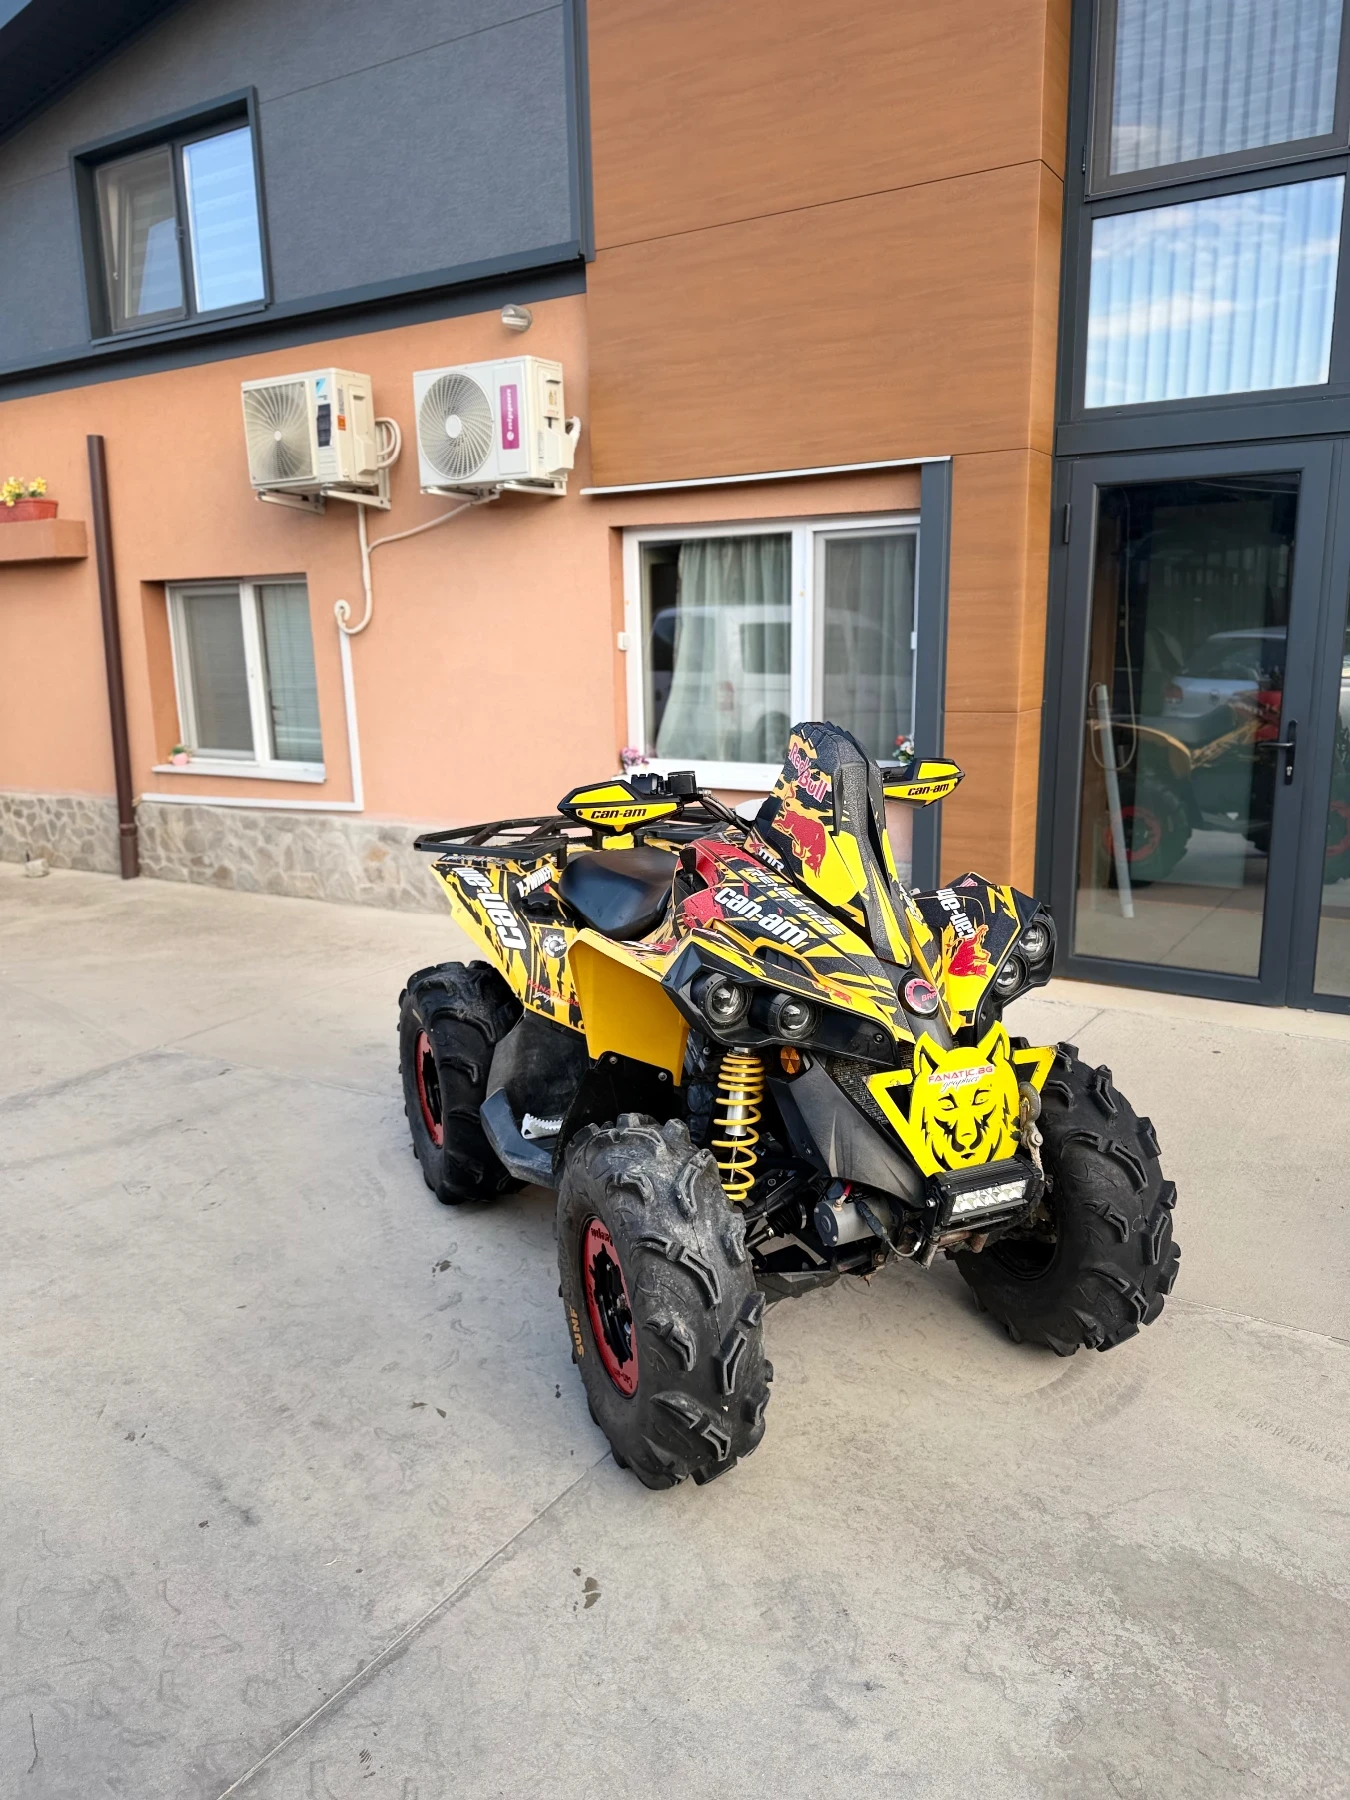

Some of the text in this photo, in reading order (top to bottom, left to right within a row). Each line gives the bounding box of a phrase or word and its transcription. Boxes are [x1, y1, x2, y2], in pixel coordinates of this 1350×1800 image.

[789, 742, 828, 803] Red Bull
[907, 783, 949, 796] can-am
[590, 808, 647, 820] can-am
[452, 867, 527, 950] can-am
[714, 886, 810, 947] can-am
[936, 888, 976, 940] can-am
[921, 992, 938, 1002] BRP
[928, 1066, 993, 1083] FANATIC.BG
